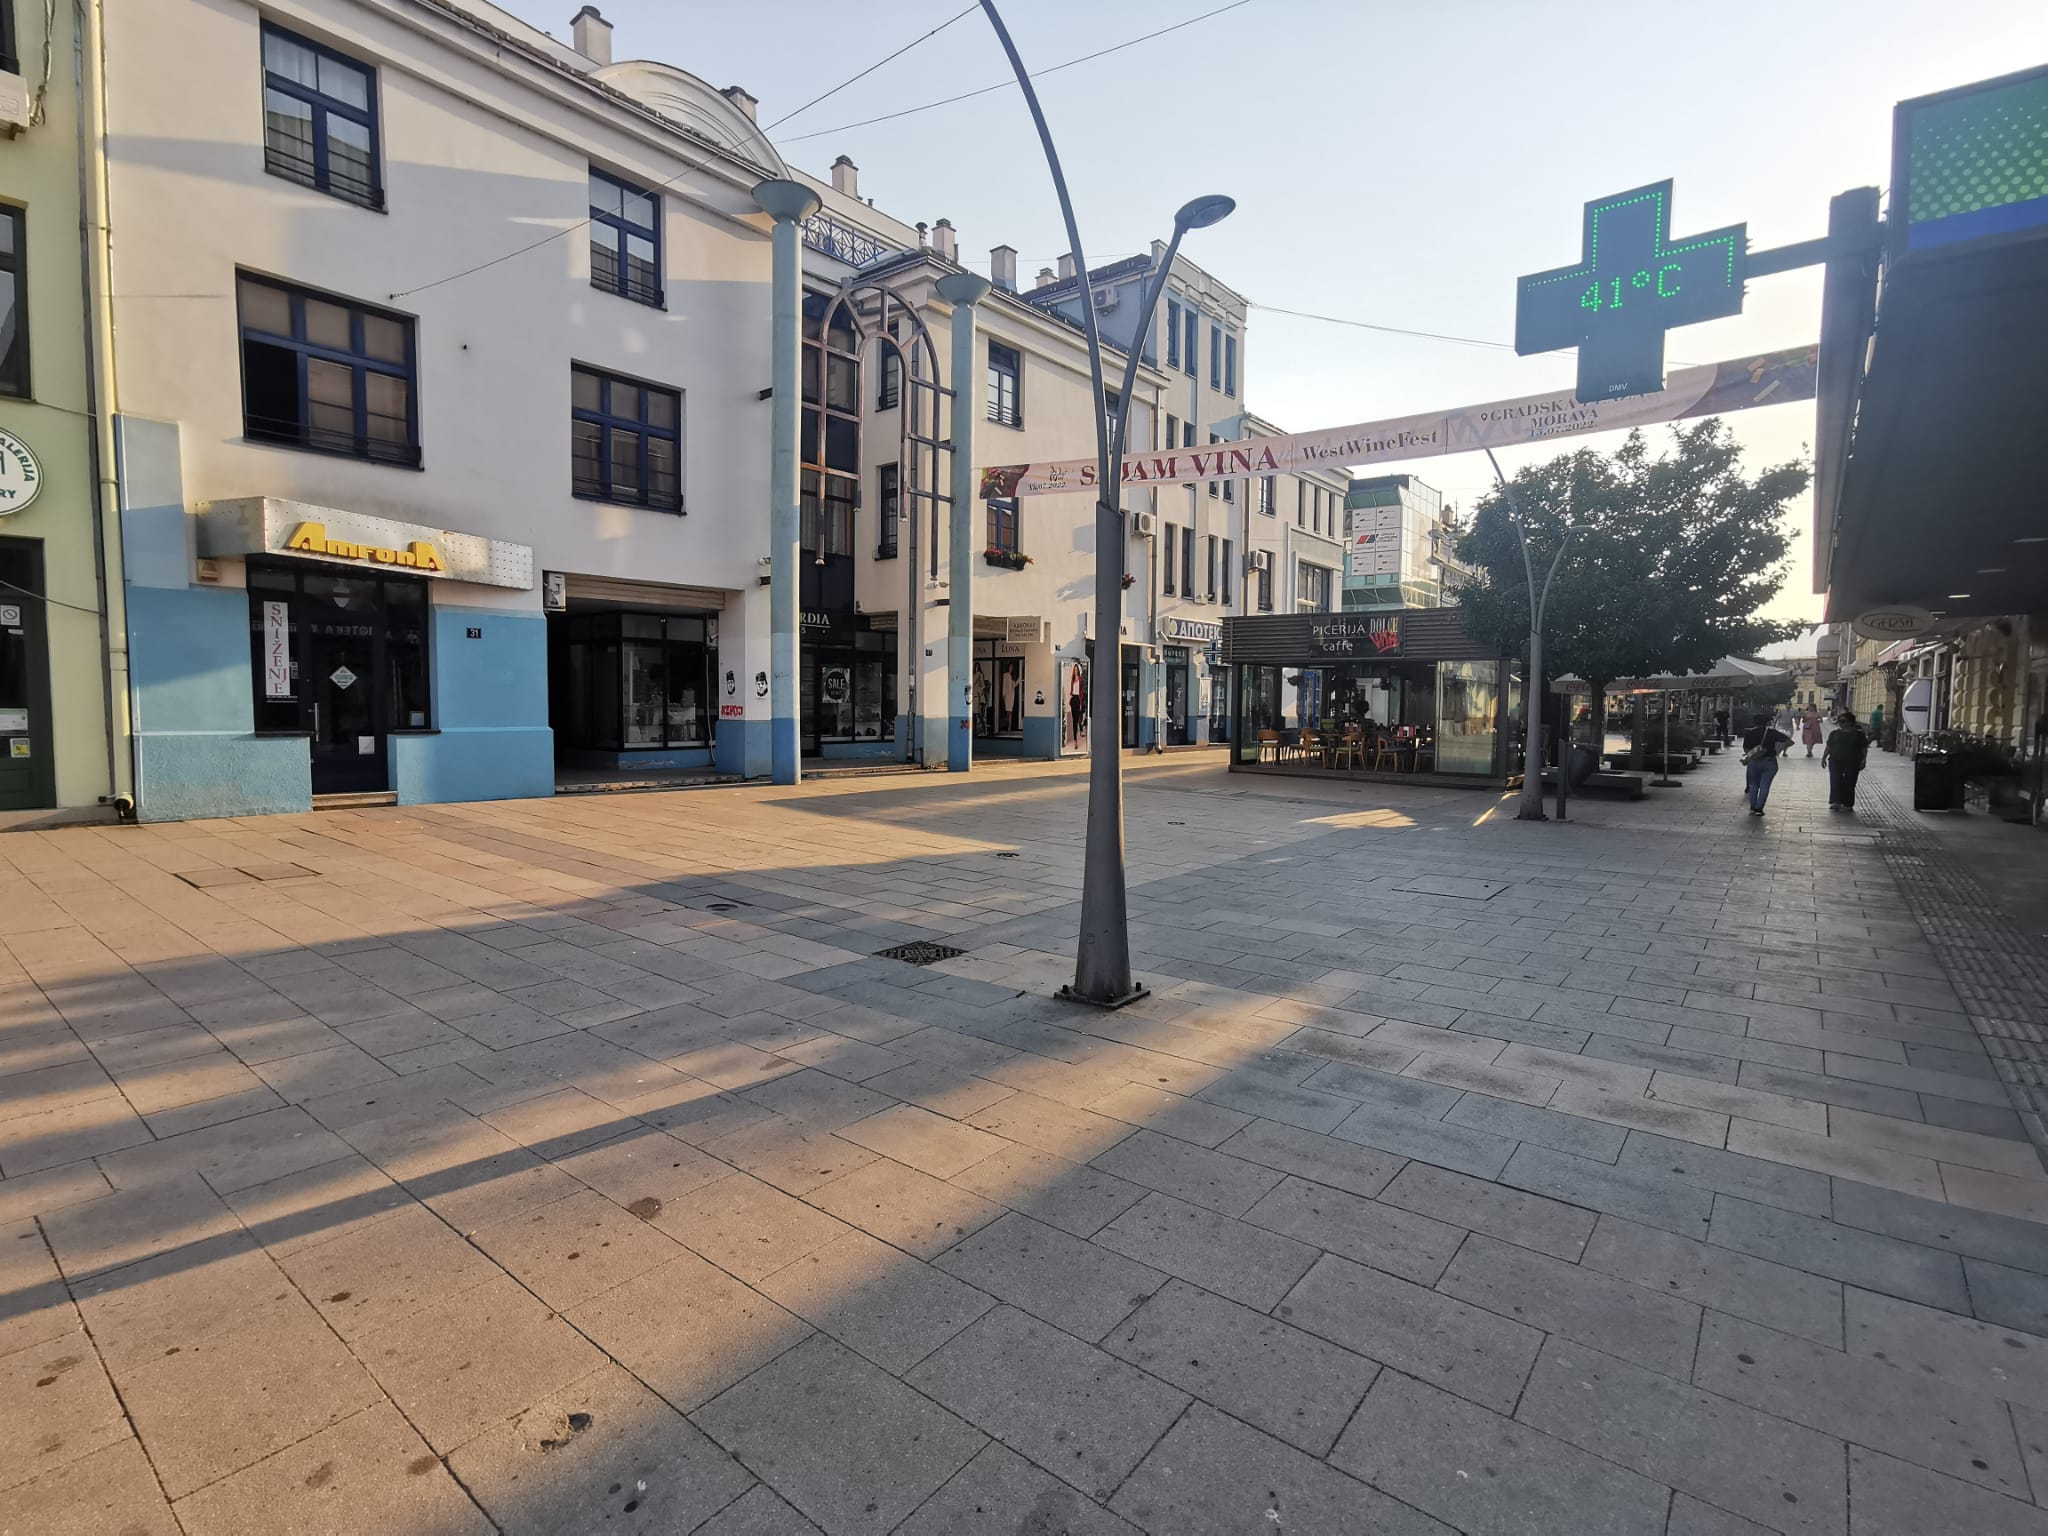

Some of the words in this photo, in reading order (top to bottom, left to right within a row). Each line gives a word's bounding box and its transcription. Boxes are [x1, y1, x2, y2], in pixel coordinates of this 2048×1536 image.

[1580, 264, 1682, 312] 41°C
[1608, 383, 1628, 392] DMV
[1490, 398, 1576, 422] GRADSKA
[1530, 408, 1599, 430] MORAVA
[1302, 430, 1437, 461] WestWineFest
[1080, 457, 1178, 486] SJAM
[1190, 446, 1280, 476] VINA
[470, 628, 479, 637] 31
[1180, 621, 1223, 640] АПОТЕК
[1313, 624, 1366, 636] PICERIJA
[1323, 639, 1353, 652] caffe
[828, 678, 845, 689] SALE
